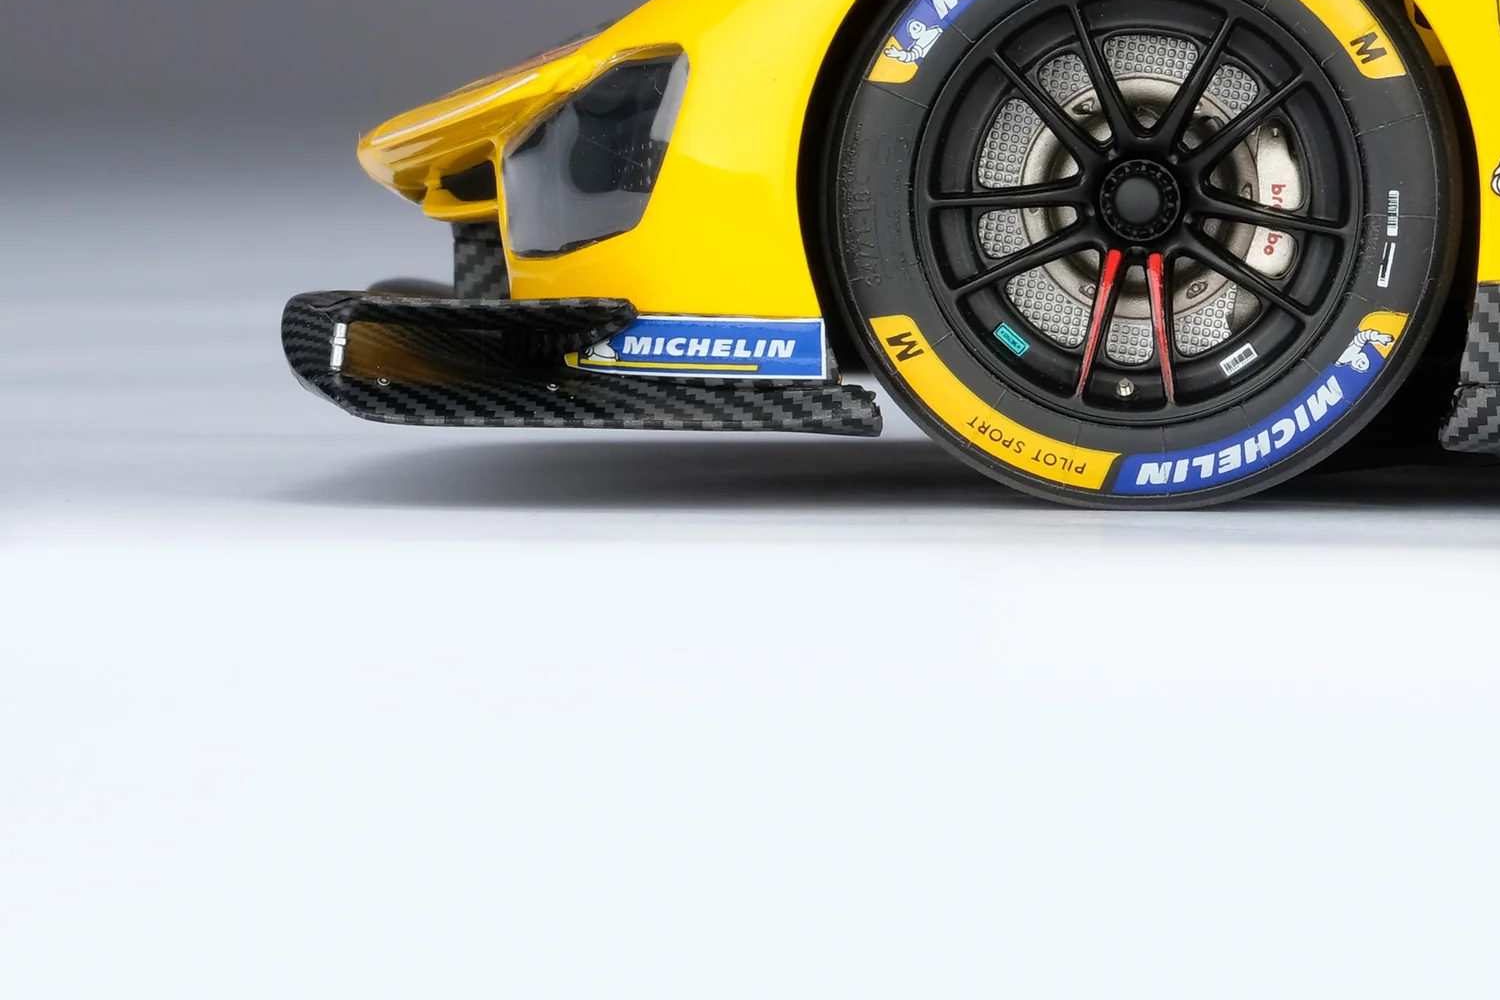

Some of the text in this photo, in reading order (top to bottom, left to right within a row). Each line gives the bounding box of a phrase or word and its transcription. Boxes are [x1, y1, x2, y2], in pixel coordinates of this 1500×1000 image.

[1350, 31, 1387, 65] M
[1263, 183, 1287, 256] brbo
[622, 335, 796, 358] MICHELIN
[885, 331, 924, 362] M
[966, 416, 1087, 475] PILOT SPORT
[1135, 375, 1344, 486] MICHELIN
